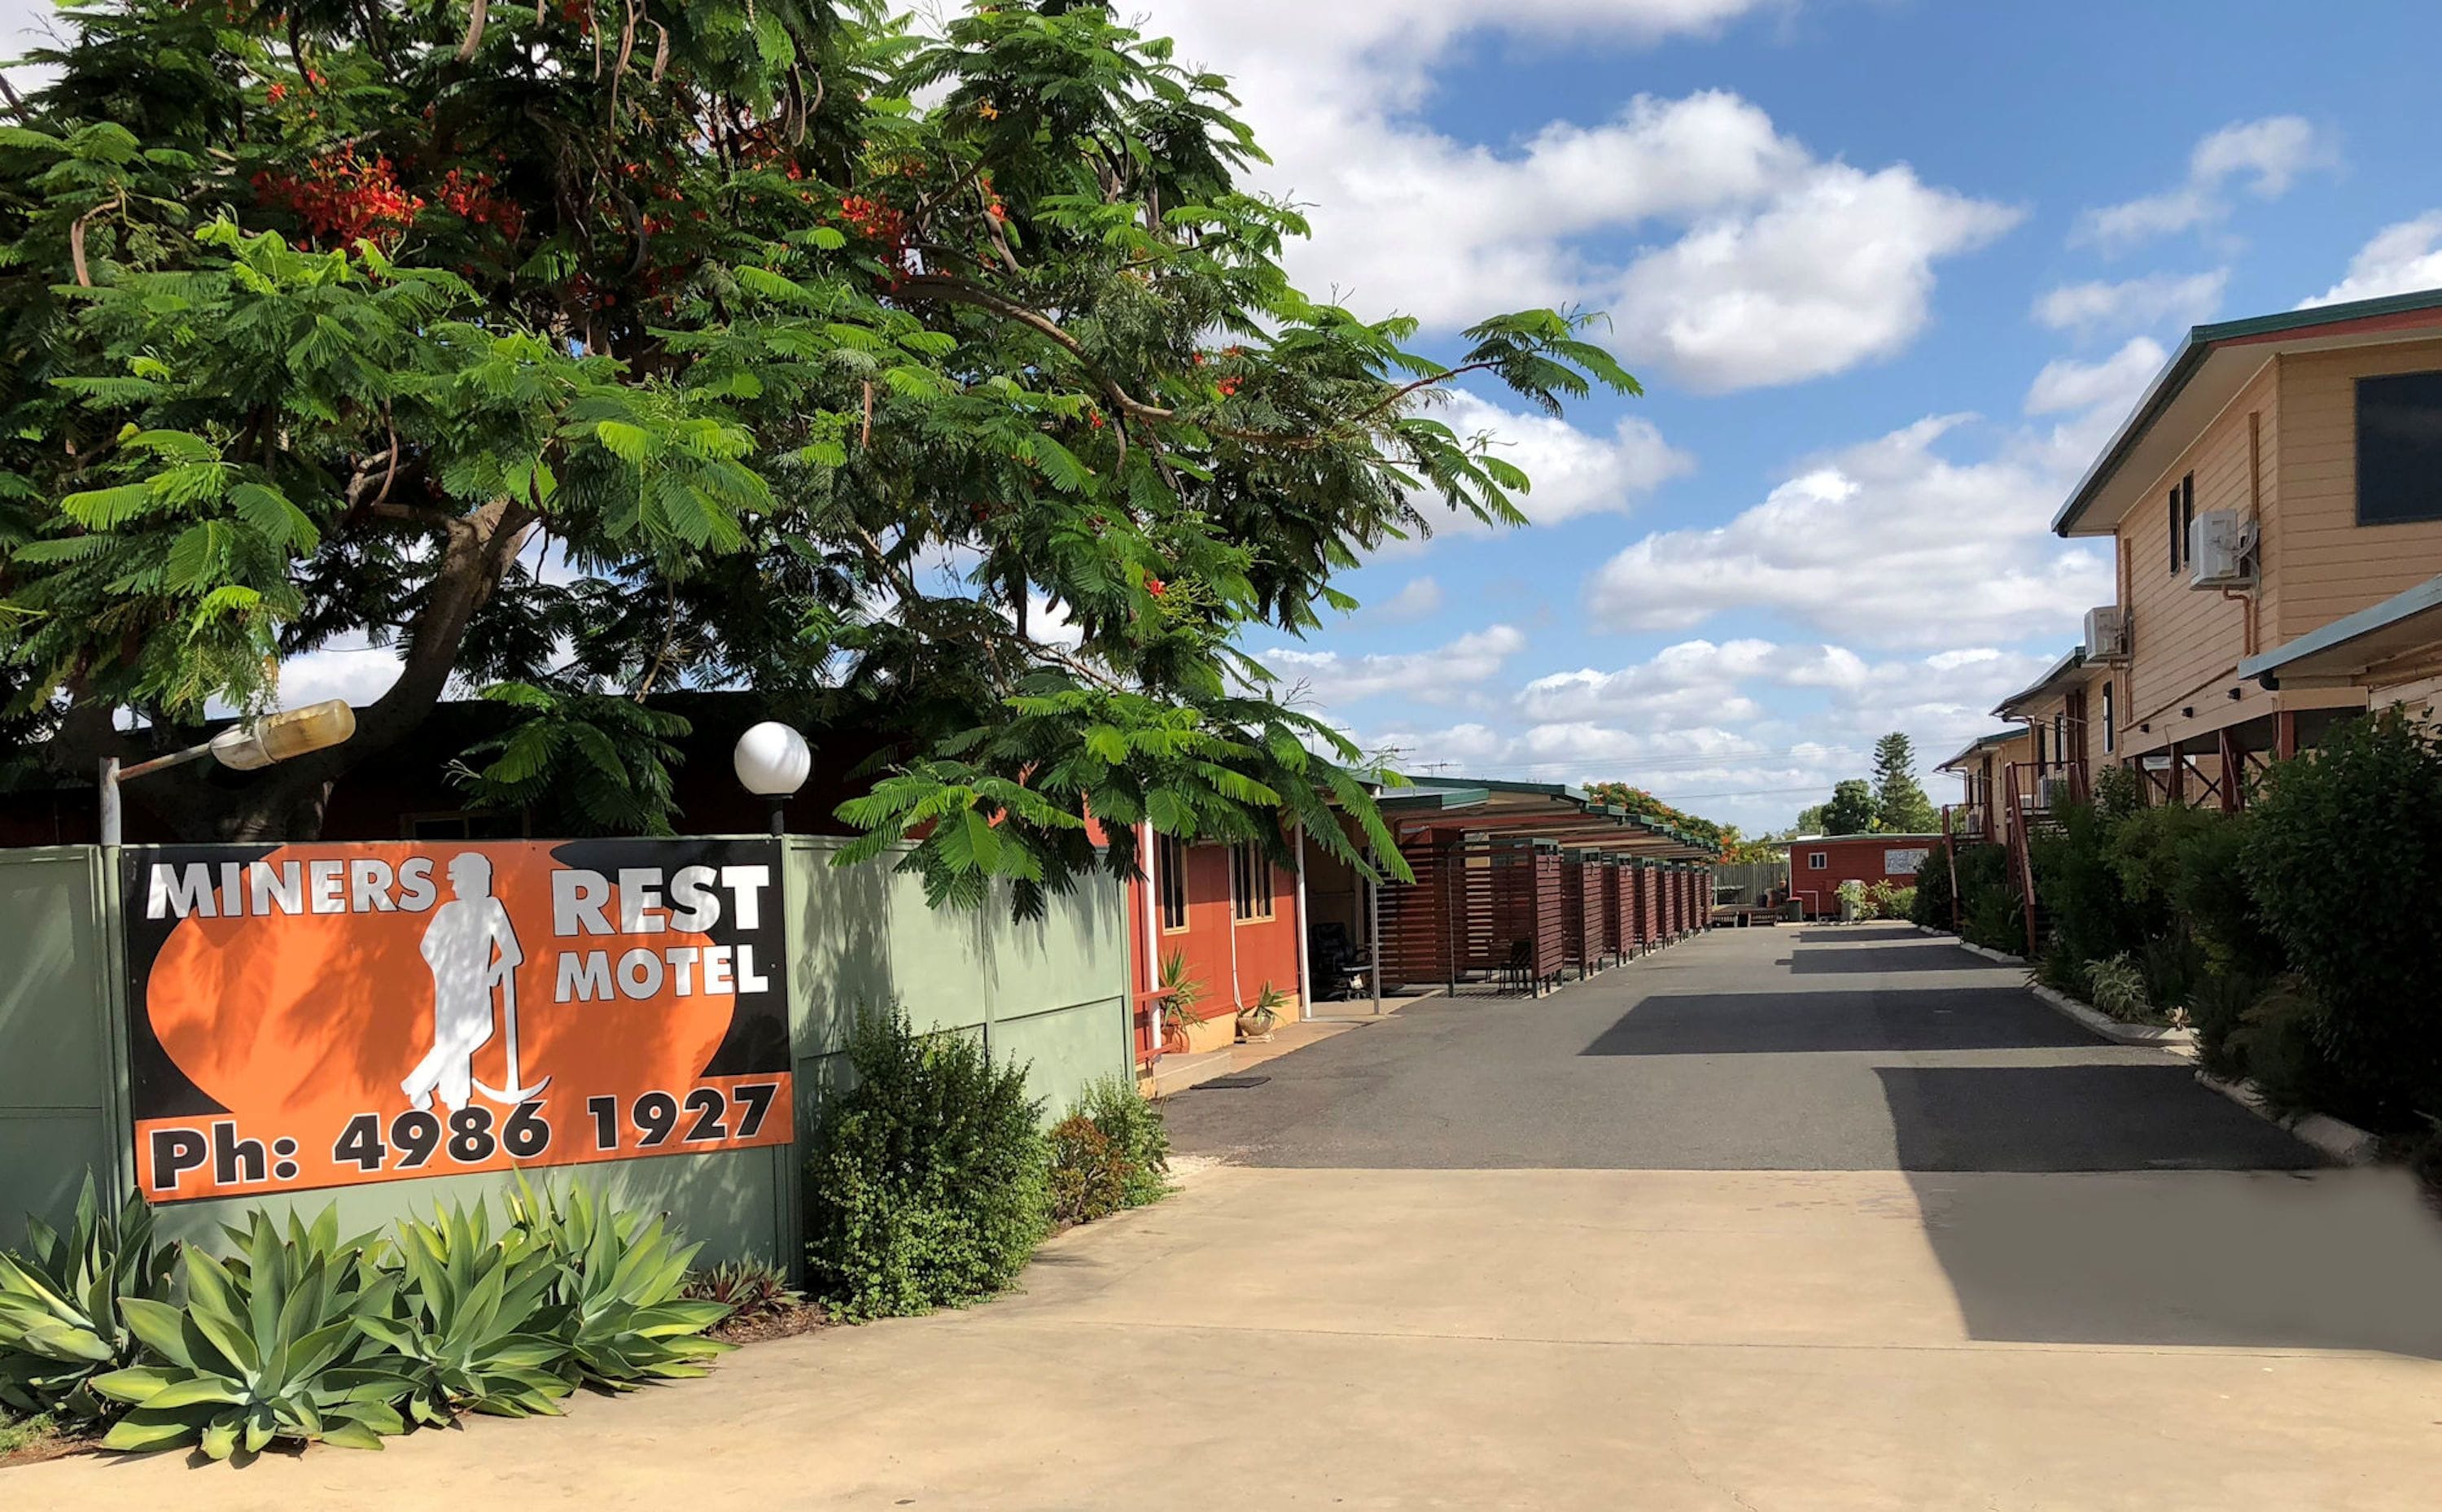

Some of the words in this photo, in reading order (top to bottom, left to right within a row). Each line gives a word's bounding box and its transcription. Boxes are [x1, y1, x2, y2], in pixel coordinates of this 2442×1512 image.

[147, 857, 438, 920] MINERS
[550, 865, 770, 937] REST
[554, 944, 769, 1003] MOTEL
[149, 1120, 300, 1192] Ph:
[331, 1099, 551, 1172] 4986
[586, 1082, 780, 1151] 1927
